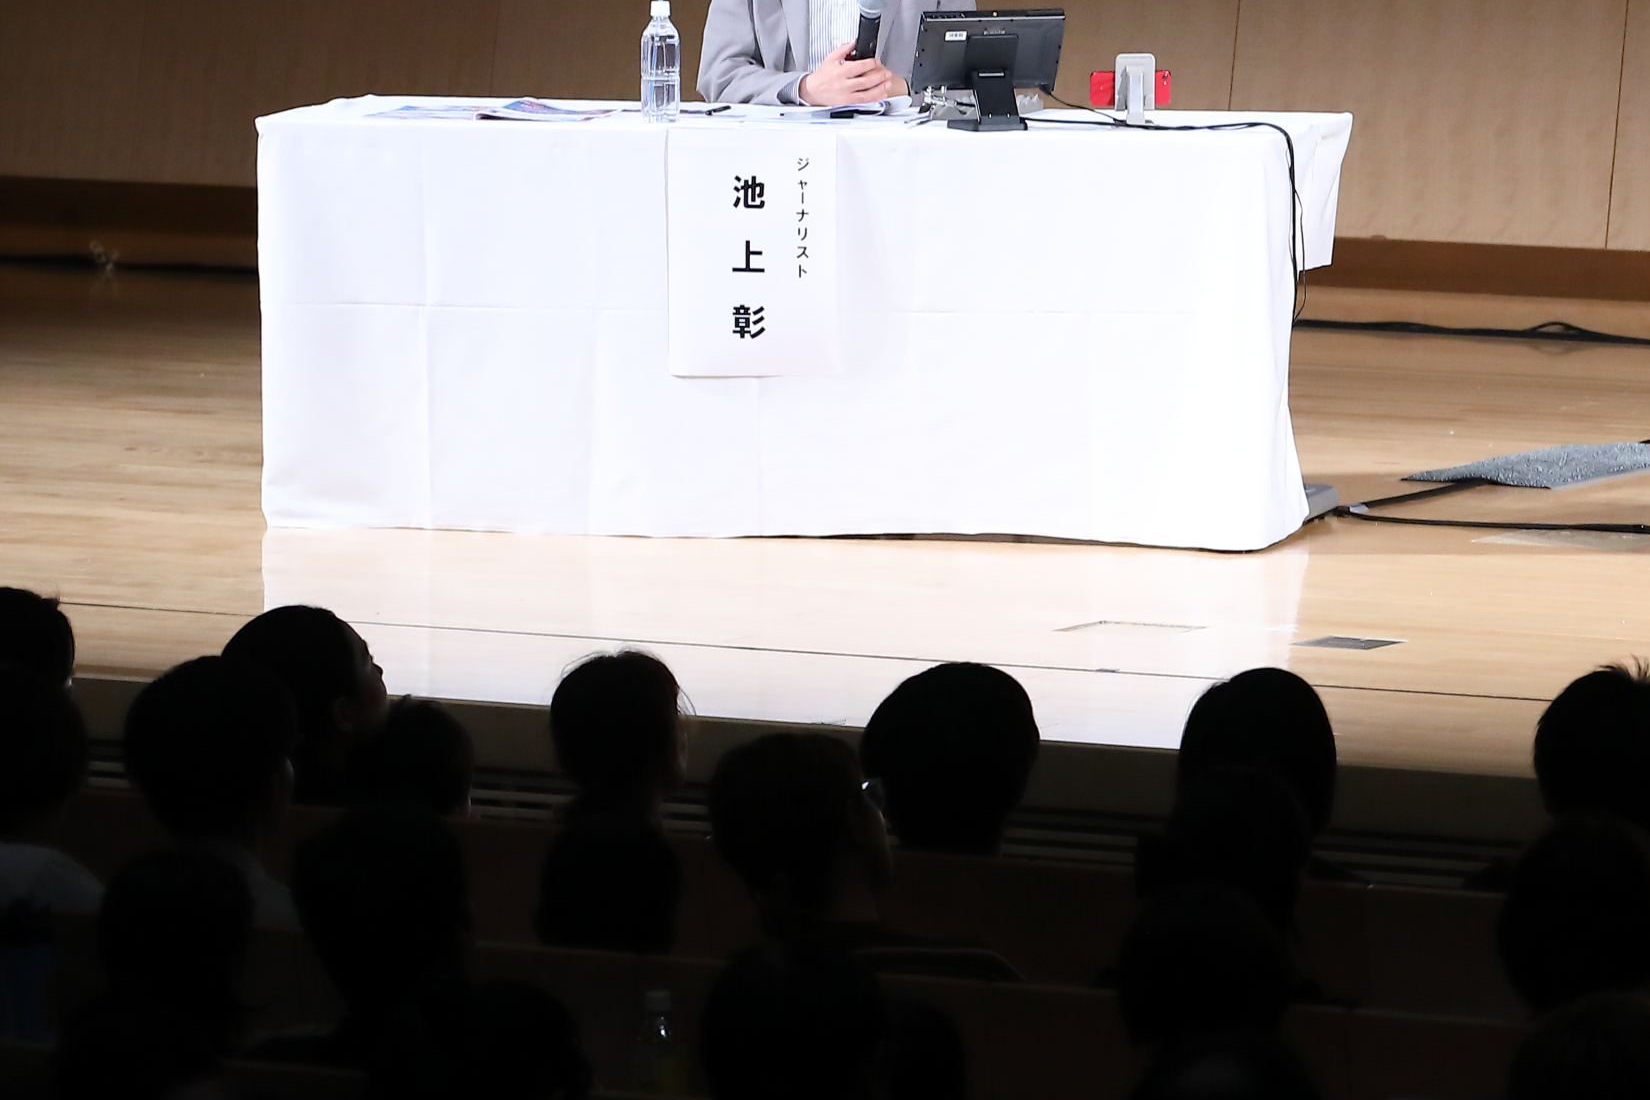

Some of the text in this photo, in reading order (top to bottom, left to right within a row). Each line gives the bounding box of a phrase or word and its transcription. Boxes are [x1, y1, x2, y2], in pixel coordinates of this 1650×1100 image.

[731, 175, 766, 339] 池上彰
[796, 157, 810, 278] ジャーナリスト
